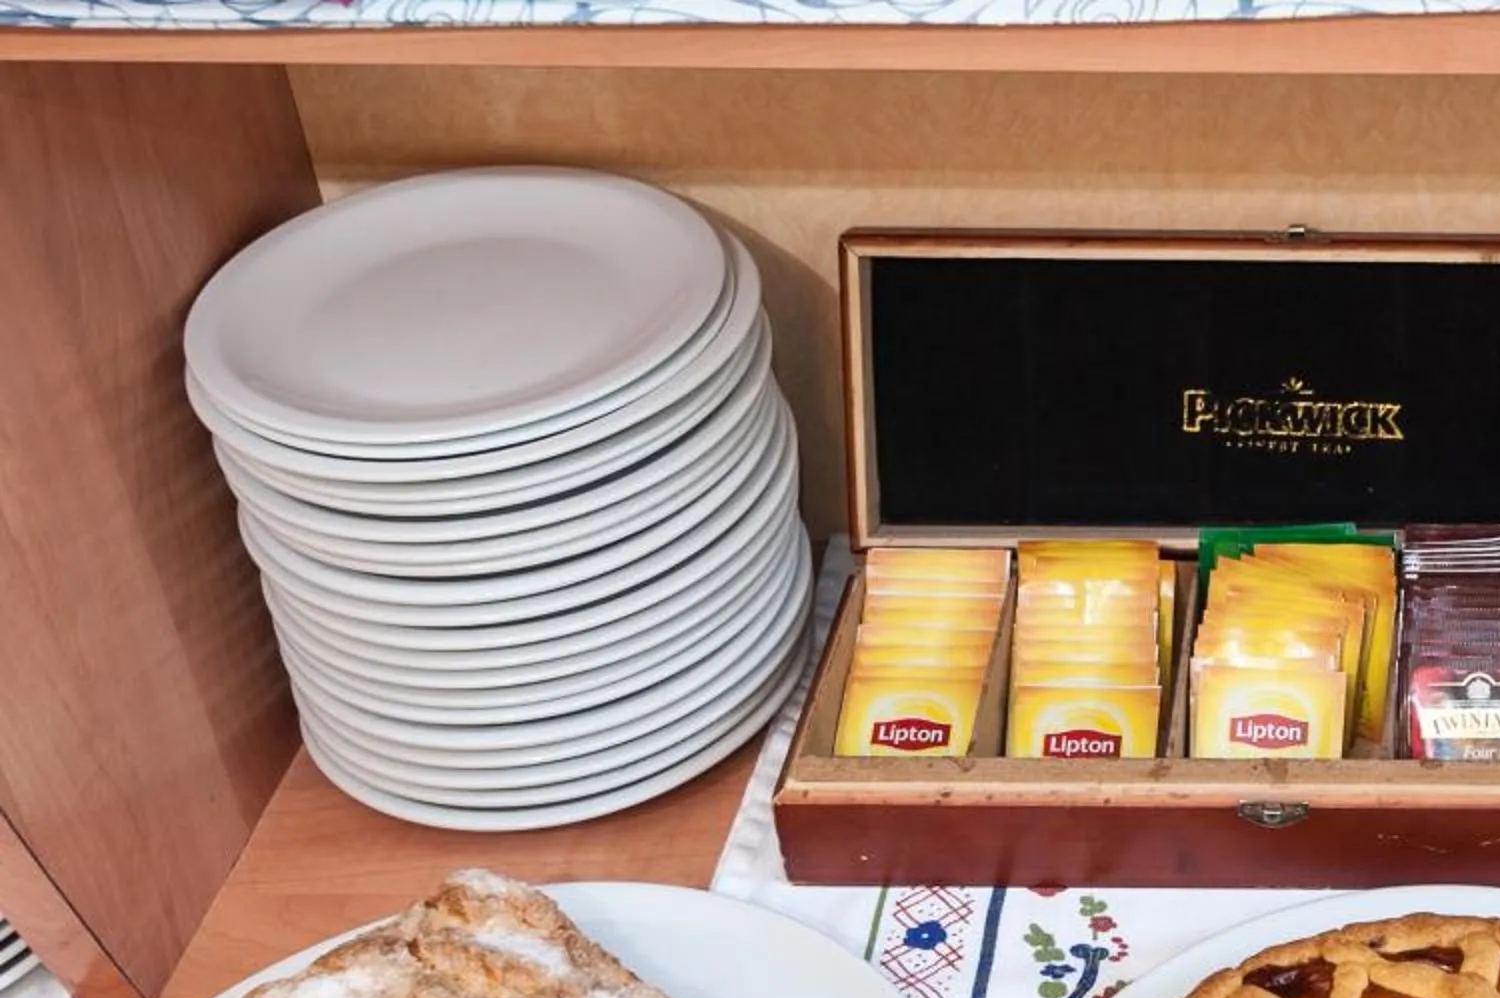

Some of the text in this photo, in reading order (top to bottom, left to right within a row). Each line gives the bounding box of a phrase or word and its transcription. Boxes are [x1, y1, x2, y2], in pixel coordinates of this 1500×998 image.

[877, 722, 944, 745] Lipton
[1235, 719, 1302, 742] Lipton
[1049, 733, 1115, 757] Lipton
